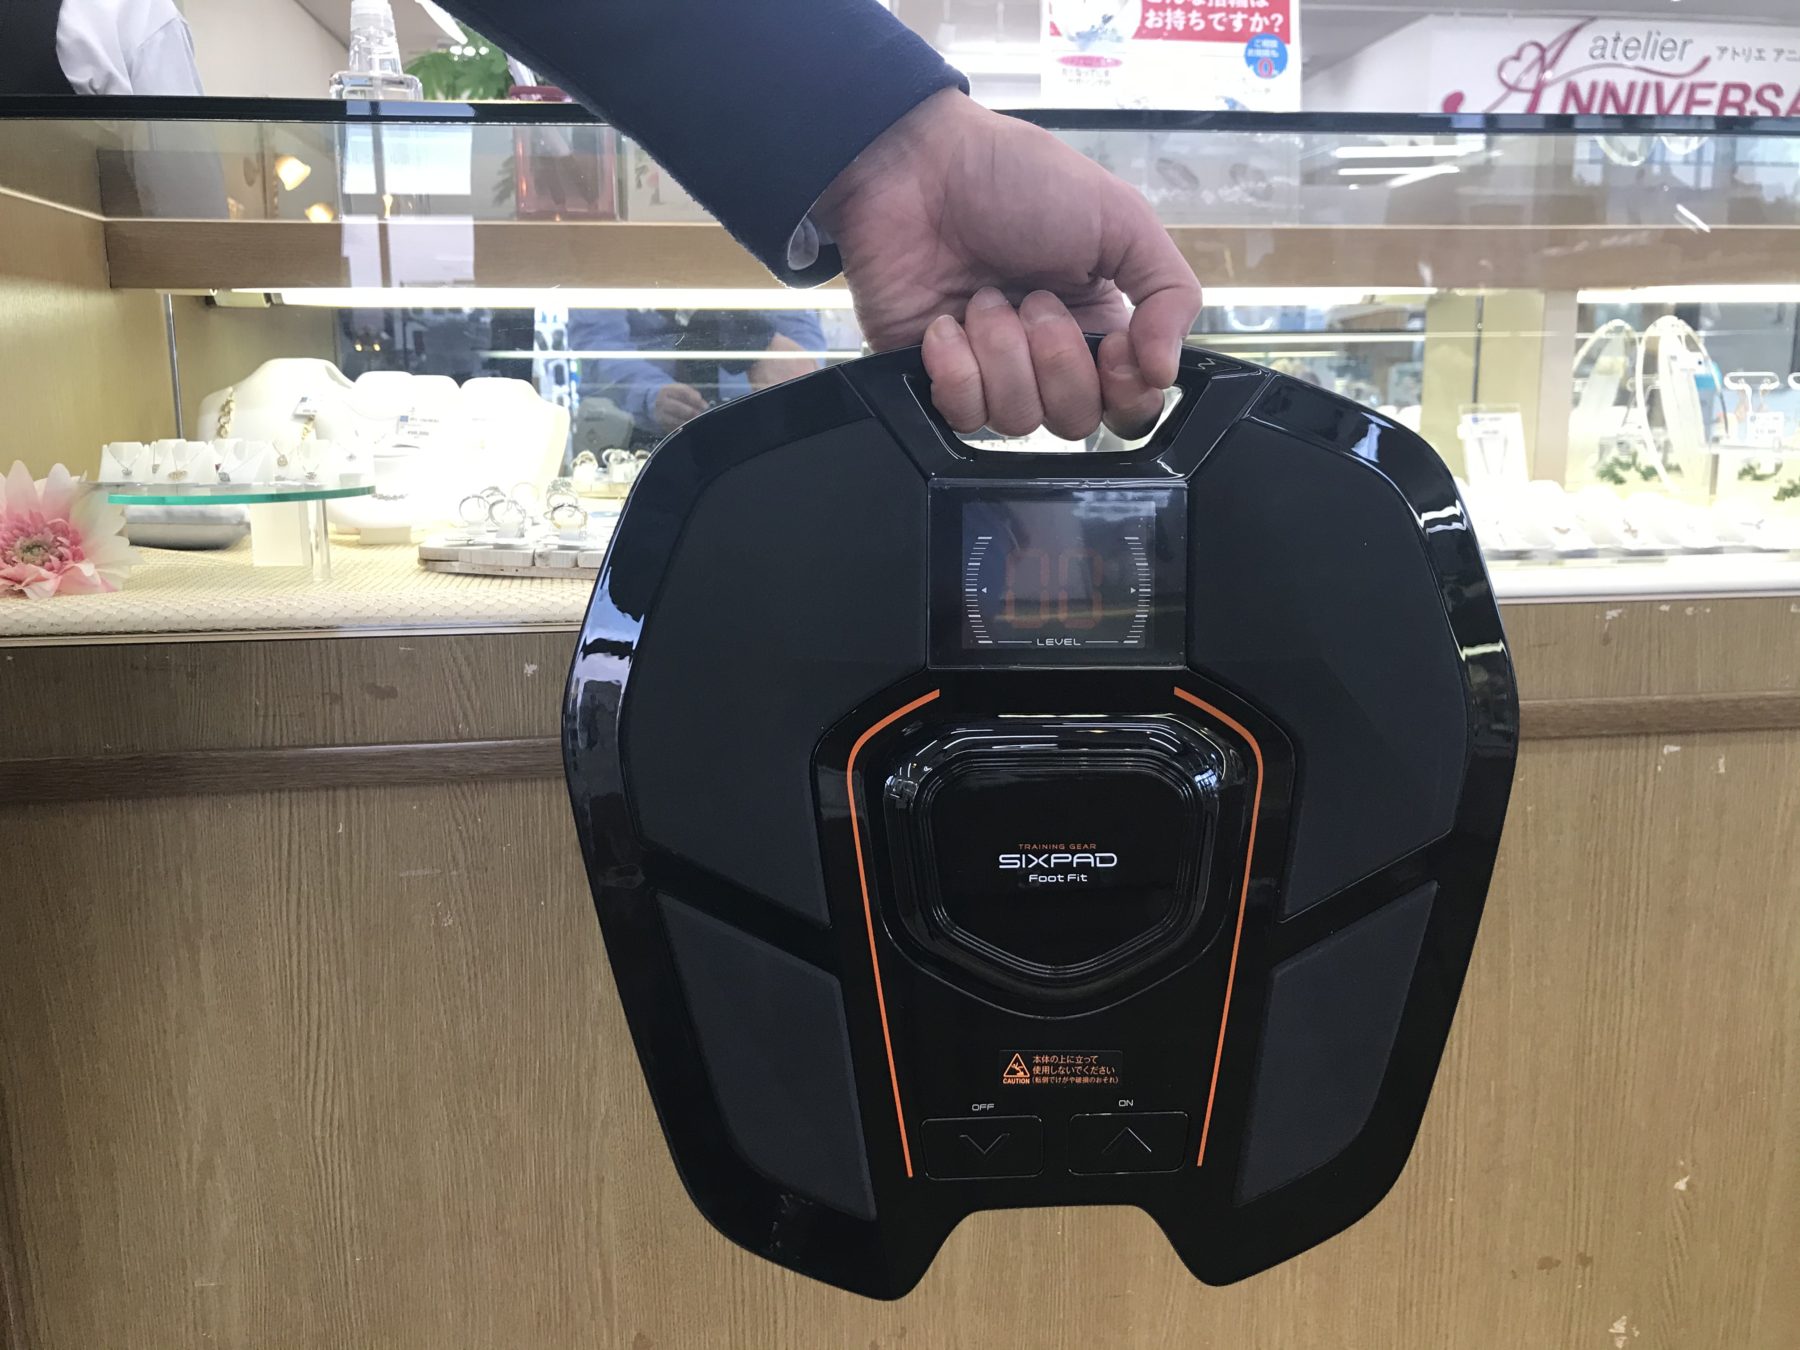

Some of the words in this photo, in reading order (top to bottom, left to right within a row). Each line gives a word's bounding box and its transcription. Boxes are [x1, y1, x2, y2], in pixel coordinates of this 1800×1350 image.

[1144, 8, 1284, 33] お持ちですか?
[1588, 30, 1694, 62] atelier
[1036, 637, 1081, 646] LEVEL
[998, 852, 1118, 869] SIXPAD
[1028, 874, 1064, 883] Foot
[1067, 873, 1088, 882] Fit
[1032, 1054, 1099, 1064] 本体の上に立って
[1032, 1065, 1115, 1075] 使用しないでください
[1002, 1077, 1030, 1085] CAUTION
[971, 1103, 995, 1112] OFF
[1118, 1099, 1134, 1107] ON
